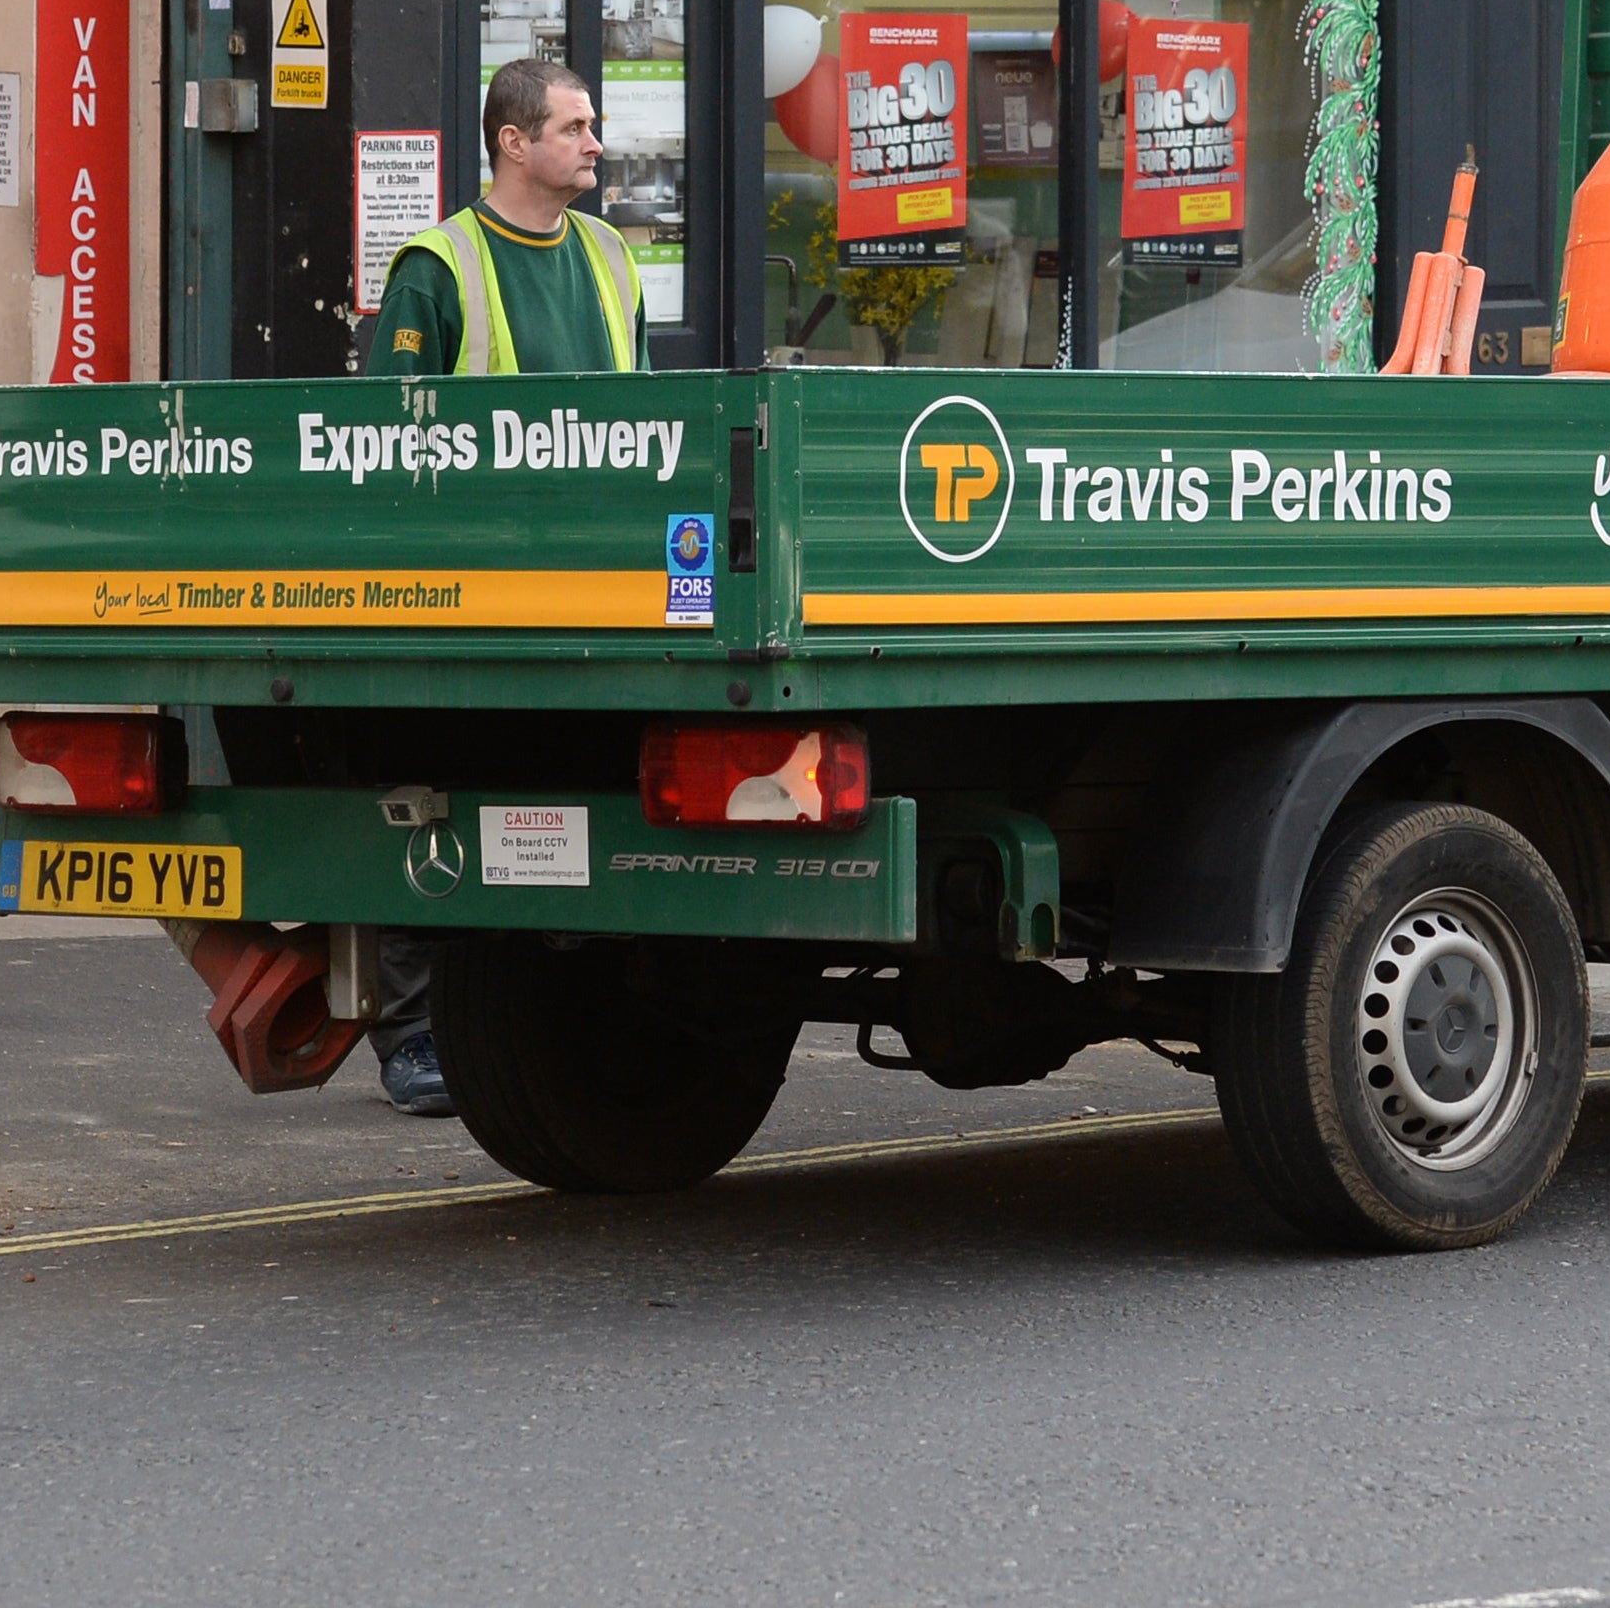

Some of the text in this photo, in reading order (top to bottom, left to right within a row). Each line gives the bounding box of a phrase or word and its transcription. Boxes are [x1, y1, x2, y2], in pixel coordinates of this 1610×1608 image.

[869, 28, 938, 38] BENCHMARX
[1156, 33, 1221, 45] BENCHMARX
[70, 16, 98, 127] VAN
[278, 71, 322, 85] DANGER
[845, 70, 871, 88] THE
[995, 72, 1033, 84] neue
[1133, 74, 1157, 91] THE
[300, 89, 322, 99] trucks
[847, 59, 956, 129] BIG 30
[1134, 66, 1237, 130] BIG 30
[361, 140, 435, 152] PARKING RULES
[850, 122, 954, 149] 30 TRADE DEALS
[1136, 126, 1233, 150] 30 TRADE DEALS
[361, 159, 435, 170] Restrictions start
[851, 139, 956, 173] FOR 30 DAYS
[1137, 144, 1235, 173] FOR 30 DAYS
[376, 174, 420, 185] at 8:30am
[1478, 332, 1509, 364] 63
[100, 426, 253, 476] Perkins
[299, 408, 685, 484] Express Delivery
[921, 444, 1452, 523] TP Travis Perkins
[135, 582, 172, 608] local
[177, 583, 246, 609] Timber
[250, 584, 267, 608] &
[272, 582, 356, 609] Builders
[362, 582, 462, 609] Merchant
[670, 578, 713, 596] FORS
[504, 812, 563, 826] CAUTION
[501, 837, 568, 847] On Board CCTV
[516, 851, 554, 861] Installed
[608, 854, 880, 878] SPRINTER 313 CDI
[36, 849, 226, 908] KP16 YVB
